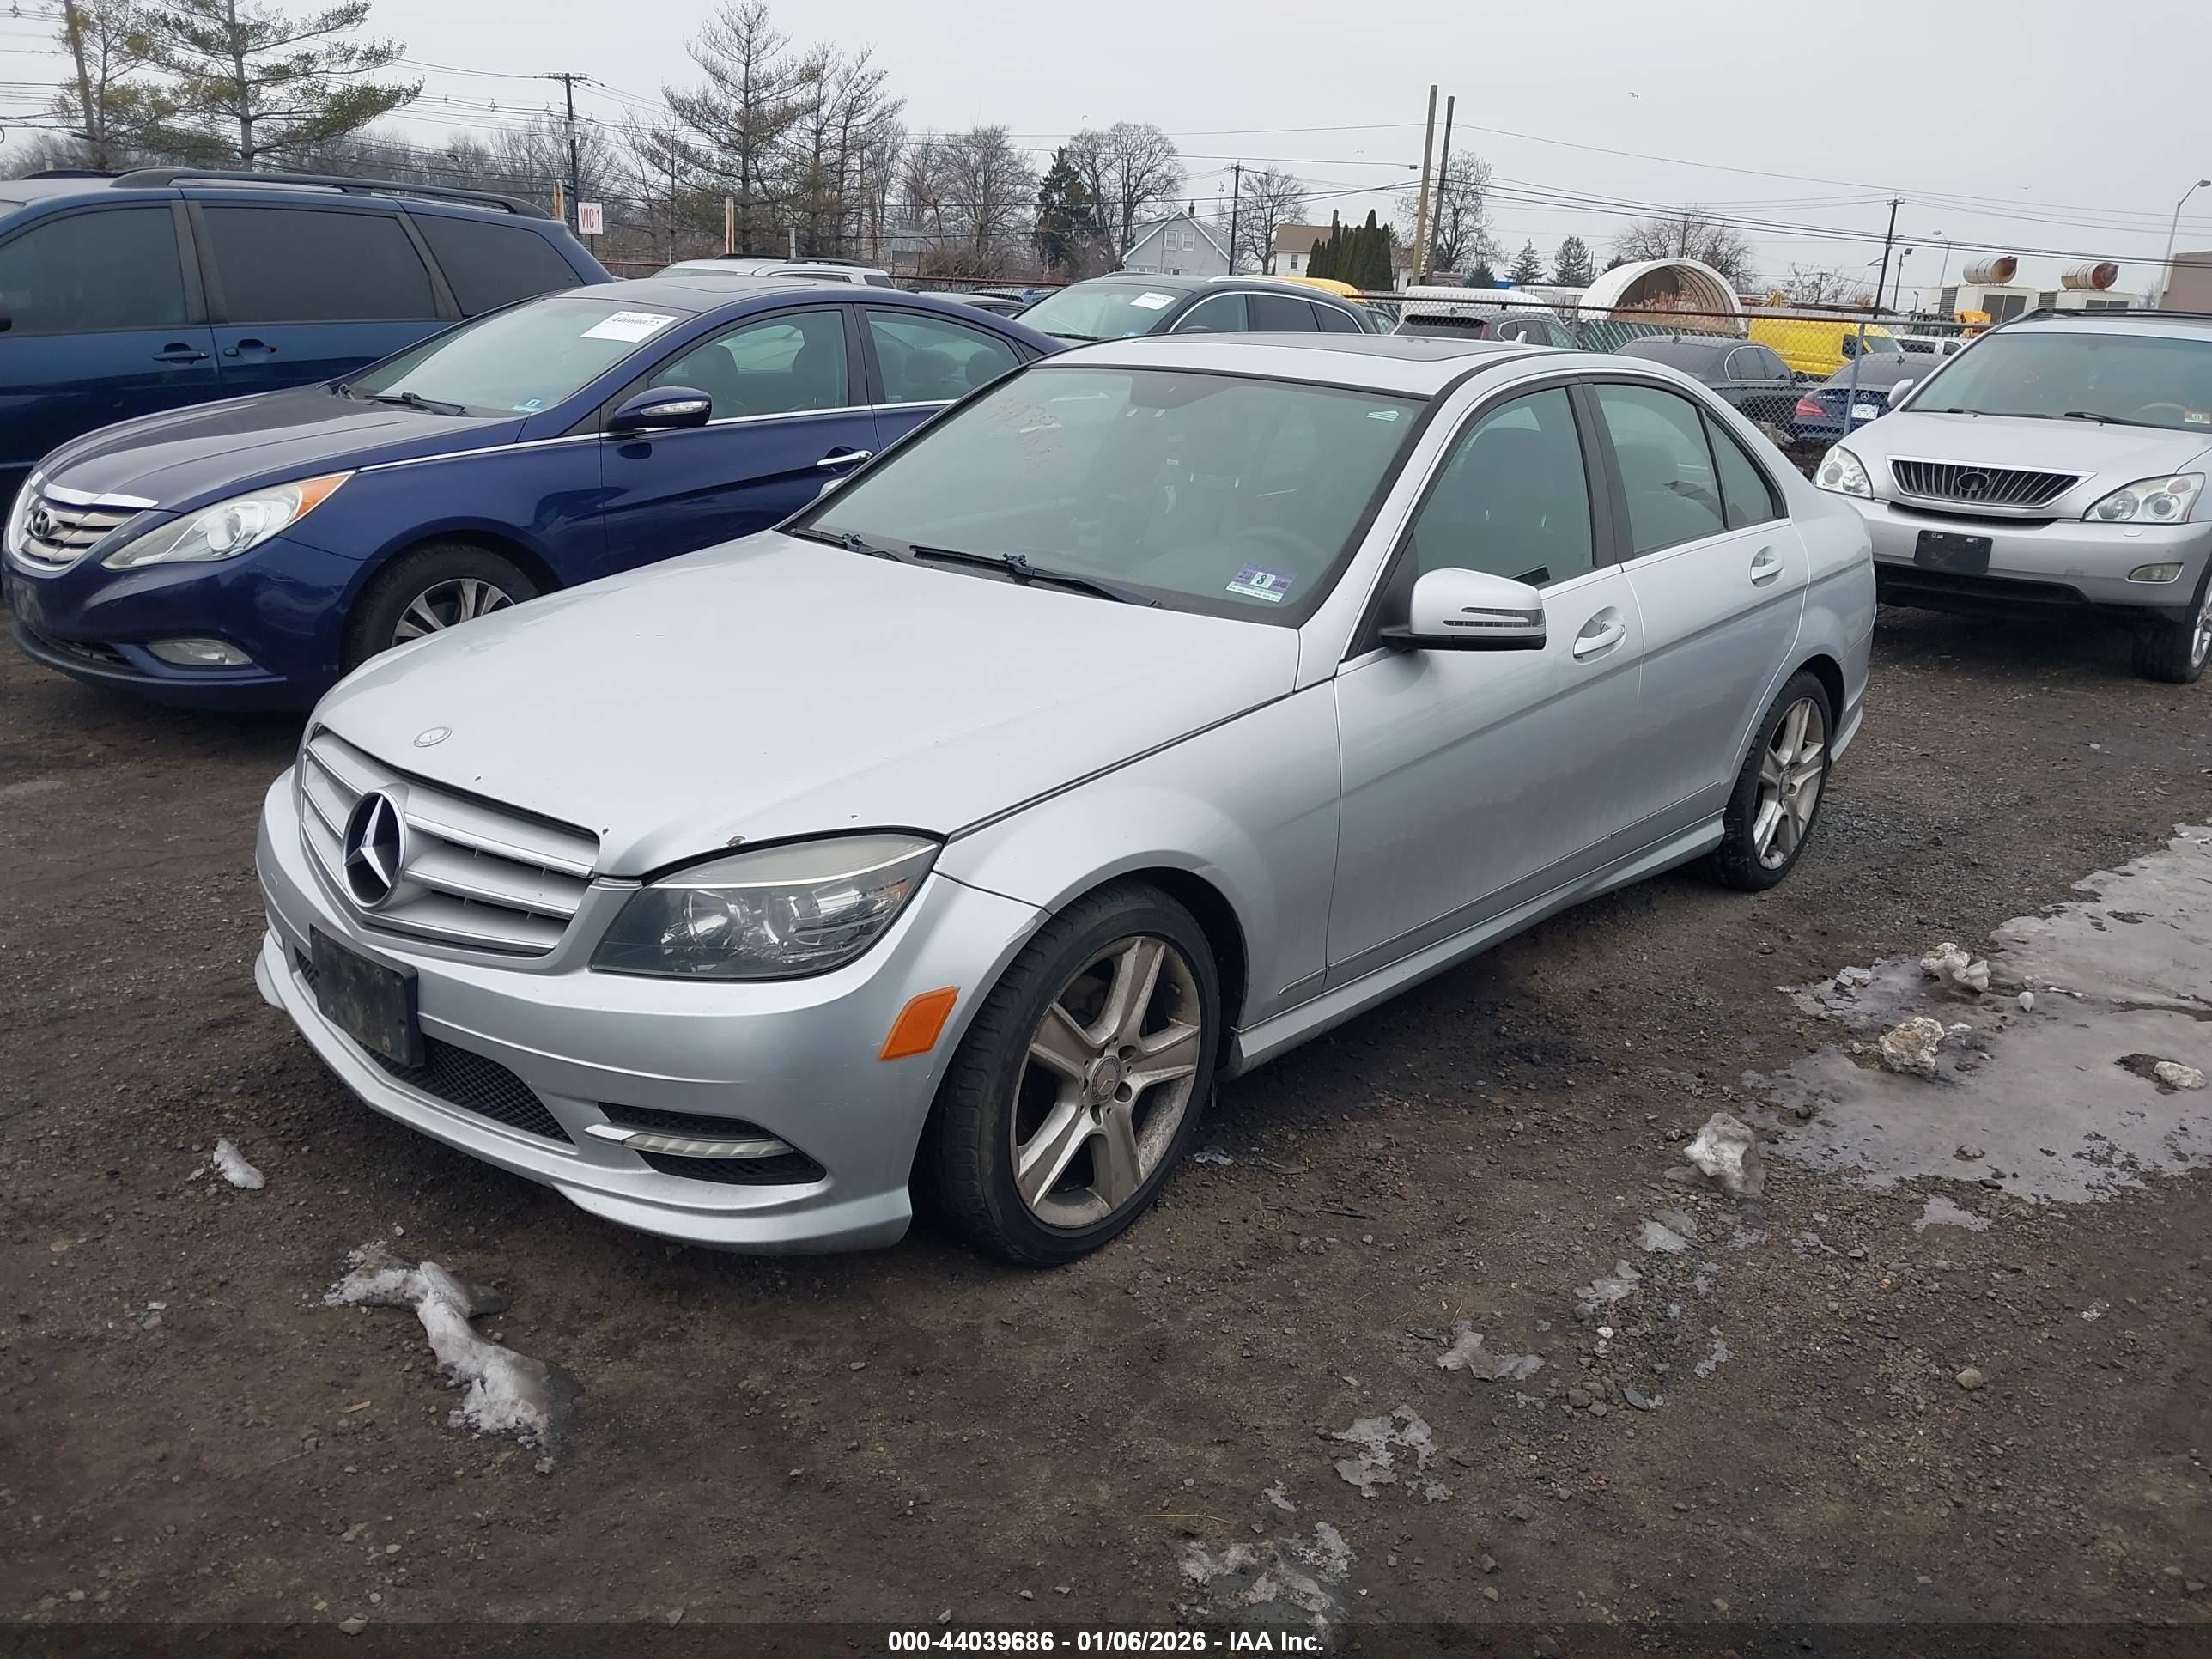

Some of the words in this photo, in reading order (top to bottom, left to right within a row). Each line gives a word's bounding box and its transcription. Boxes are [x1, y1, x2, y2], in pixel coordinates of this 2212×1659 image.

[580, 208, 594, 228] VIC
[596, 210, 600, 228] 1
[1256, 574, 1267, 585] 8
